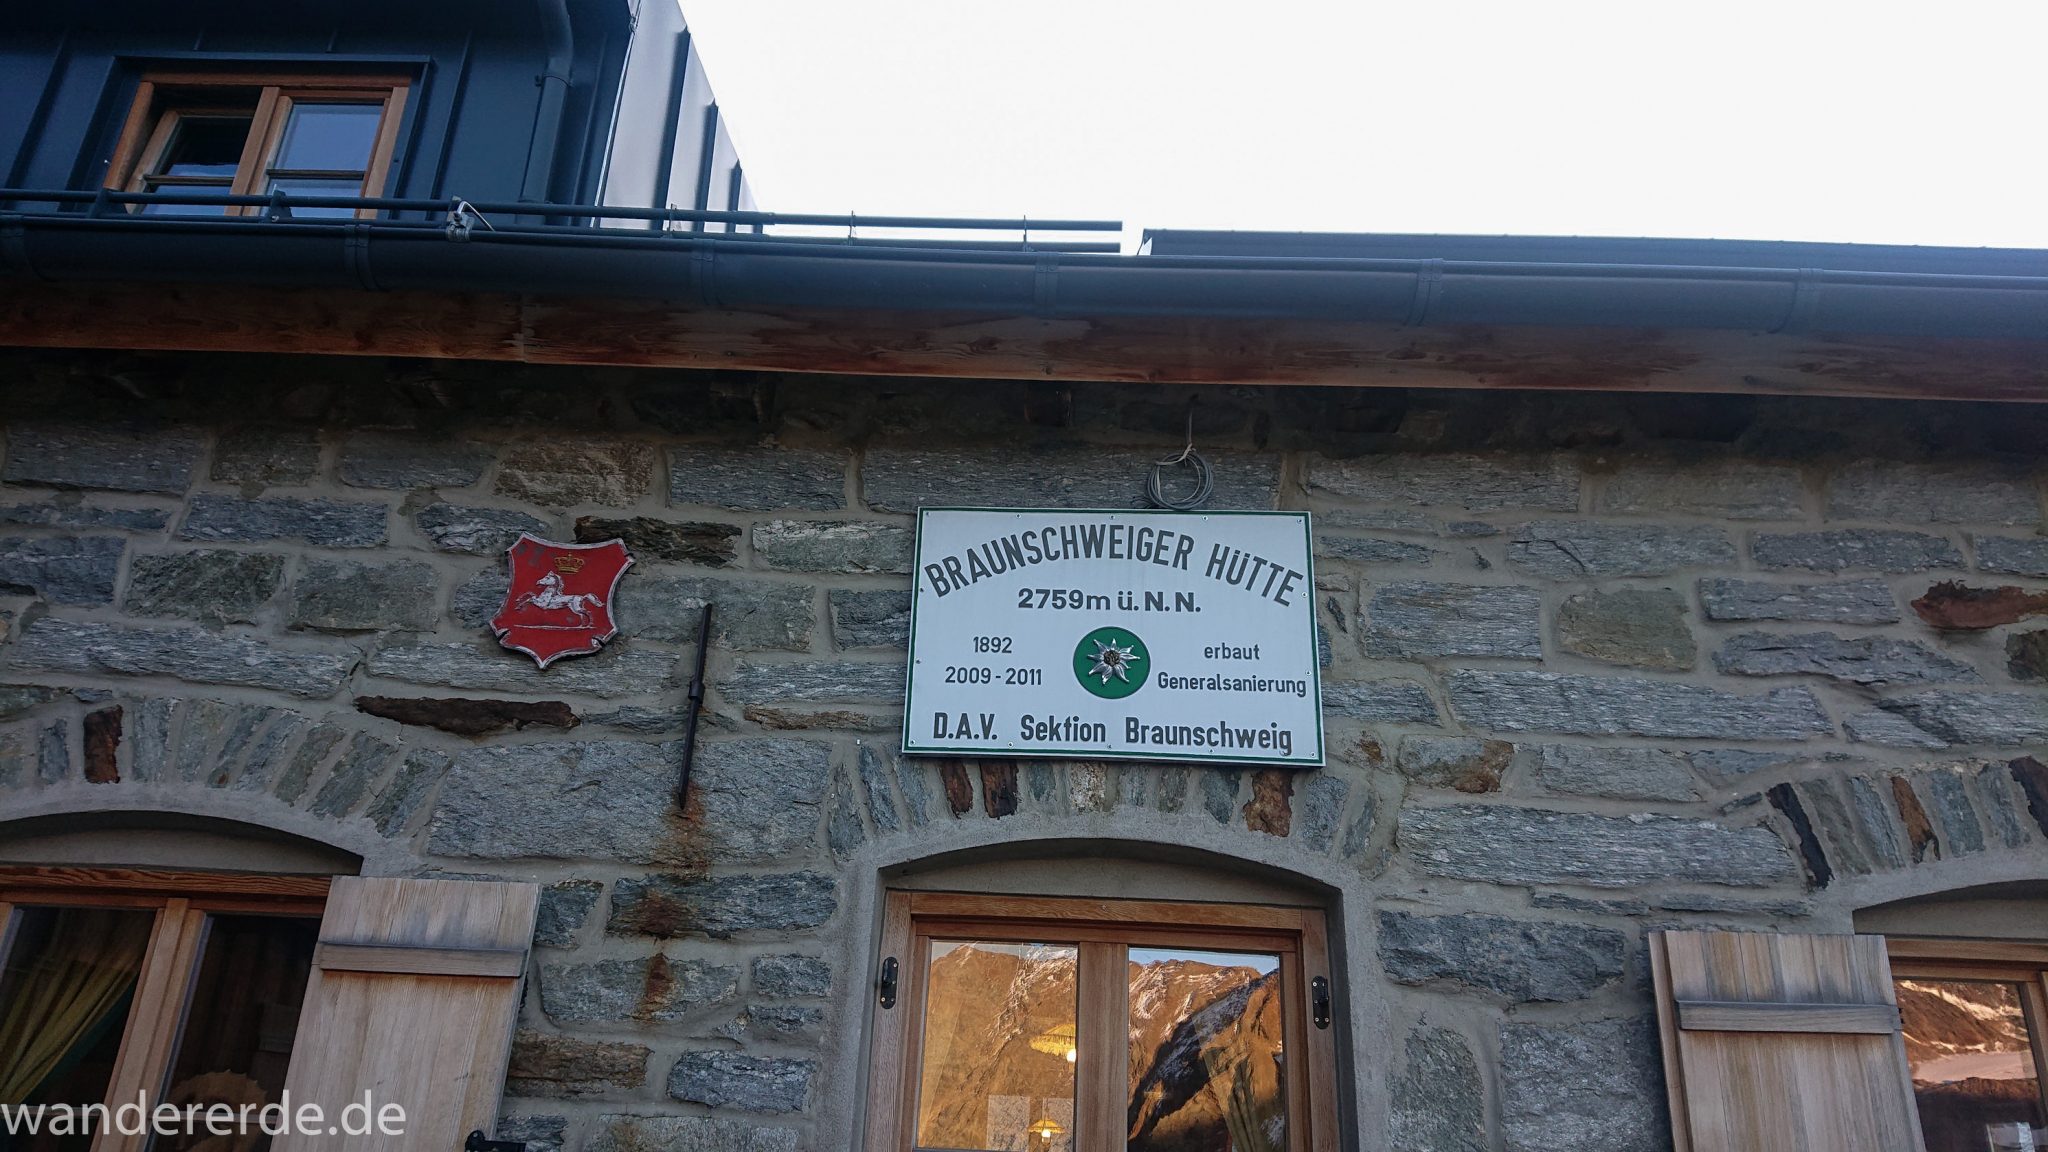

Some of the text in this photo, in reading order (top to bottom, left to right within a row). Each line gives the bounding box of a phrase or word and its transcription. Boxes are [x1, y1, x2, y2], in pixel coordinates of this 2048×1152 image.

[924, 524, 1304, 608] BRAUNSCHWEIGER HÜTTE
[972, 636, 1013, 654] 1892
[1204, 642, 1260, 661] erbaut
[1157, 671, 1307, 698] Generalsanierung
[933, 711, 1293, 757] D.A.V. Sektion Braunschweig
